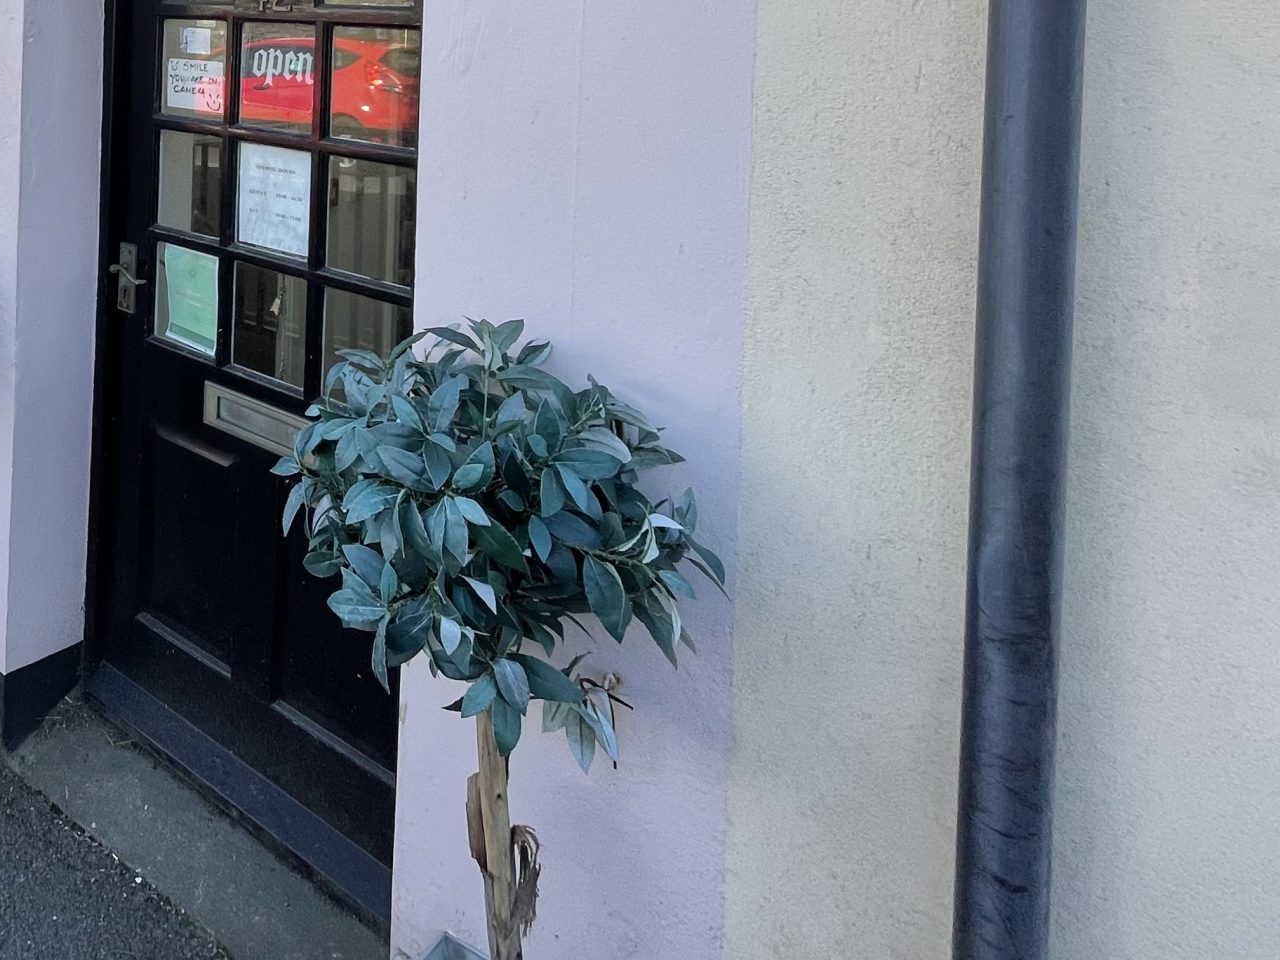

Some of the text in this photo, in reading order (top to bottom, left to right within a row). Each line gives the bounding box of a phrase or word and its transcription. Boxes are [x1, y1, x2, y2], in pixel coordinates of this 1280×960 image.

[183, 61, 208, 72] SMILE
[252, 48, 315, 87] open
[173, 85, 206, 97] CAMERA
